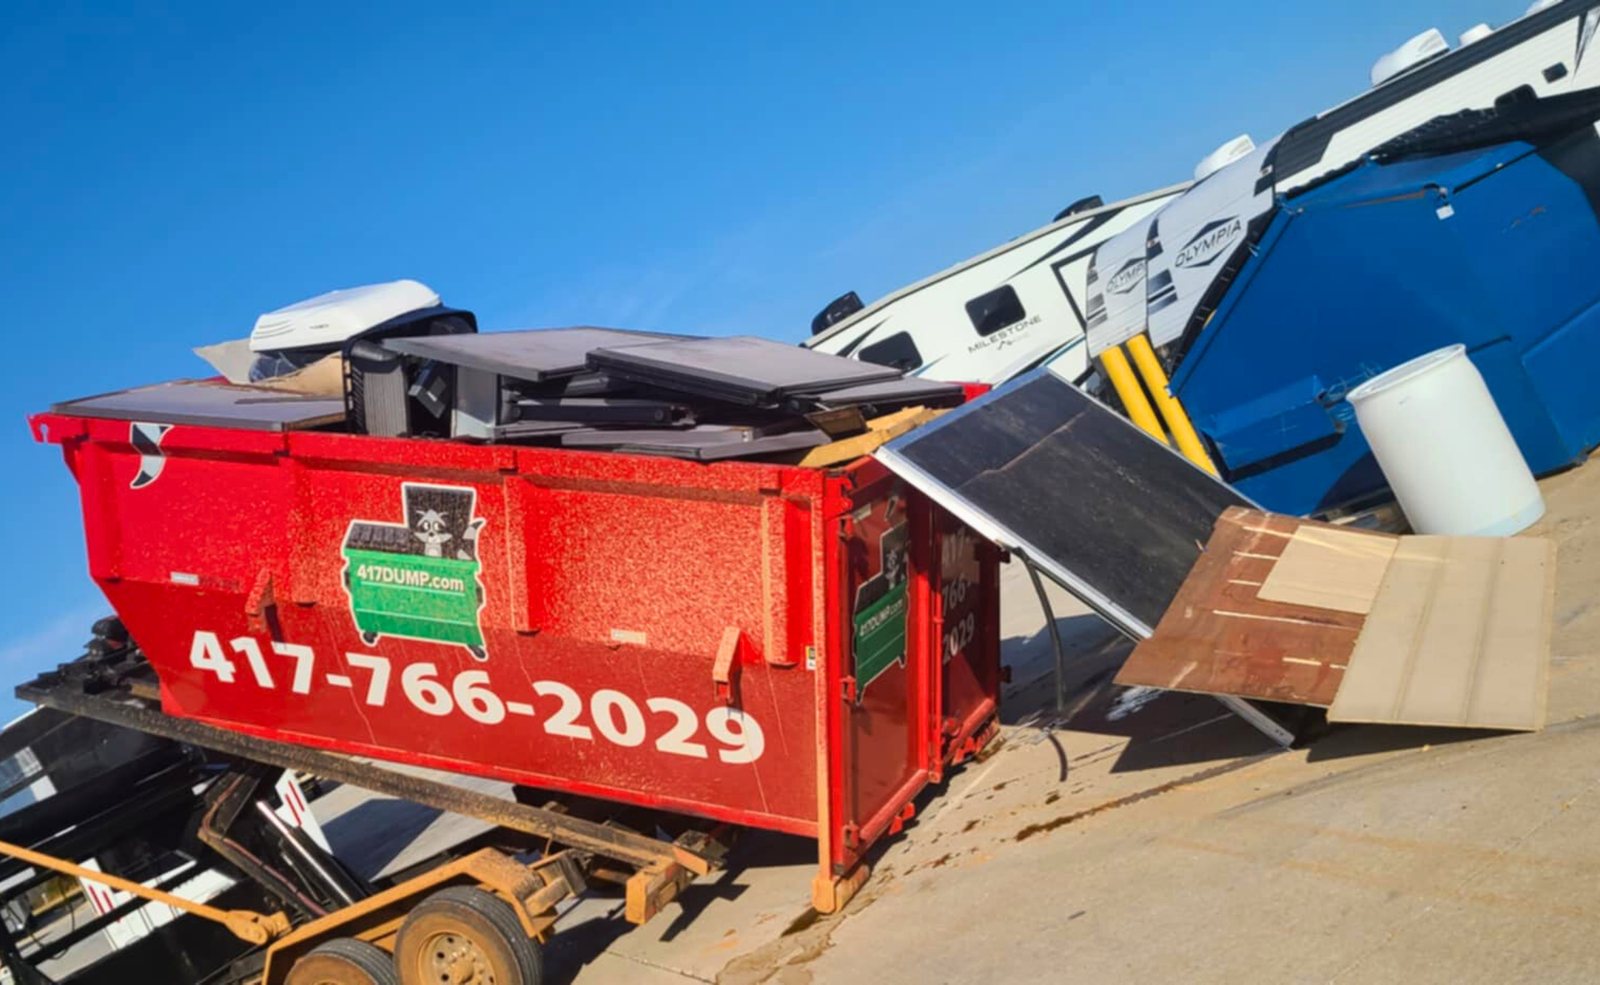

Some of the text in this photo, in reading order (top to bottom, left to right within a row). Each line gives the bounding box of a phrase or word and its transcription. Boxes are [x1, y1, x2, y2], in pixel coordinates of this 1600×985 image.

[1173, 219, 1242, 269] OLYMPIA
[1106, 261, 1147, 294] OLYMP
[967, 314, 1042, 353] MILESTONE
[356, 564, 465, 592] 417DUMP.com
[189, 630, 766, 764] 417-766-2029
